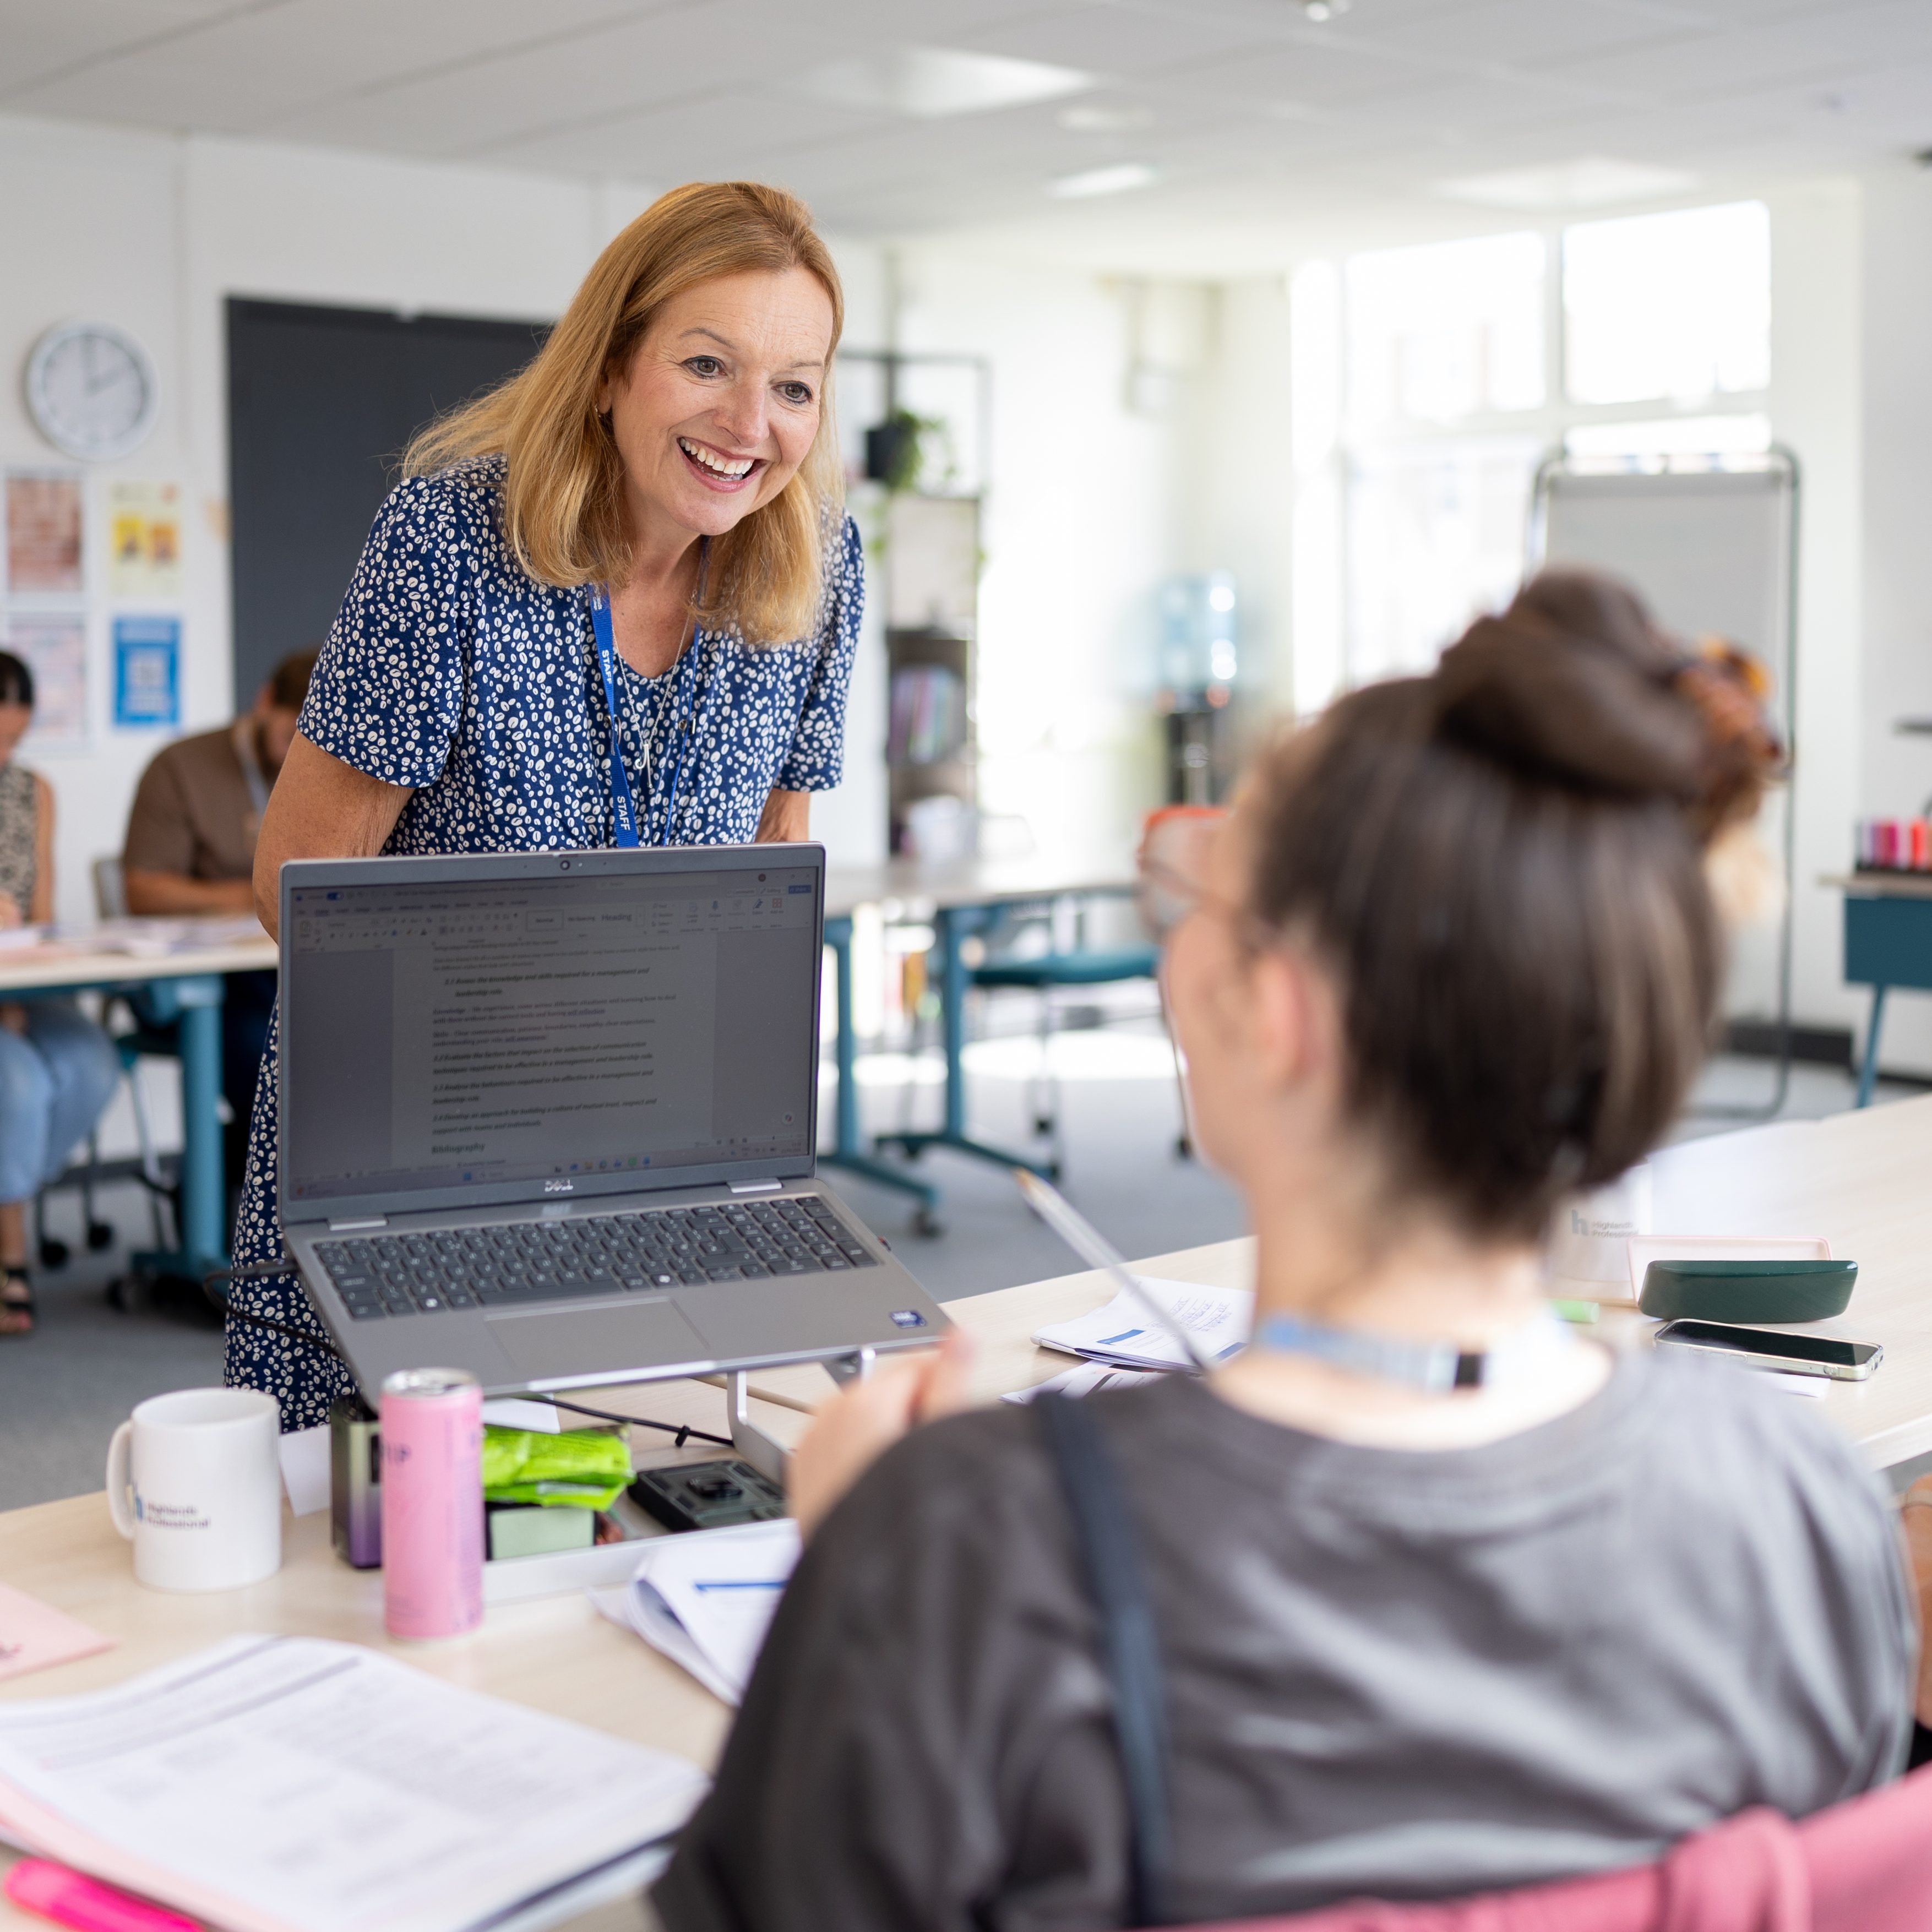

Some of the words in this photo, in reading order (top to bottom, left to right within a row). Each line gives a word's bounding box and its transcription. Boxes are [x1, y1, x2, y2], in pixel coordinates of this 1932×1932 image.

[602, 649, 612, 684] STAFF
[617, 796, 630, 831] STAFF
[601, 913, 632, 922] Heading
[488, 975, 523, 983] knowledge
[596, 968, 636, 977] management
[554, 1058, 594, 1066] management
[601, 1071, 640, 1080] management
[431, 1143, 485, 1155] Bibliography
